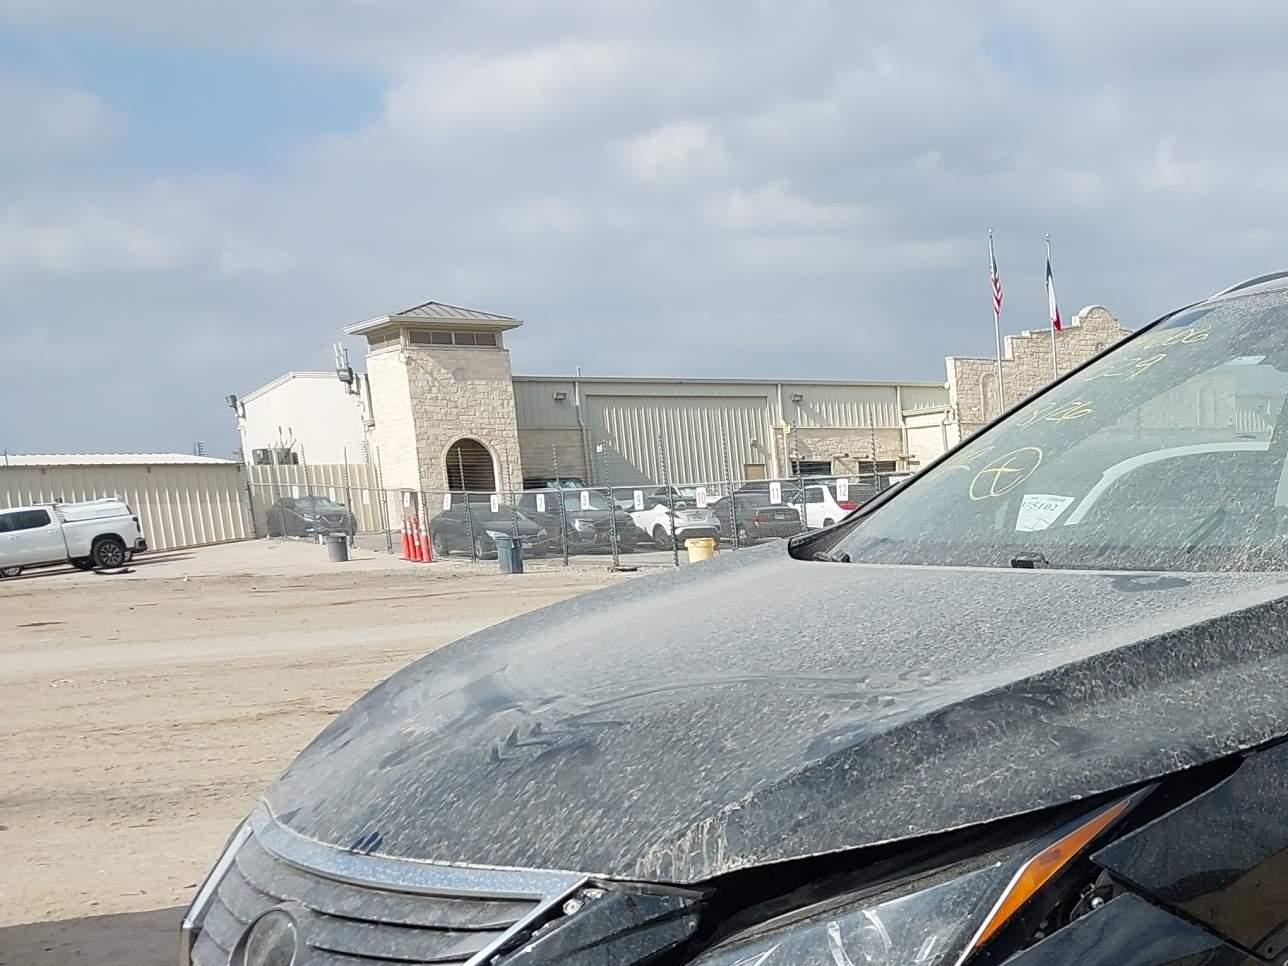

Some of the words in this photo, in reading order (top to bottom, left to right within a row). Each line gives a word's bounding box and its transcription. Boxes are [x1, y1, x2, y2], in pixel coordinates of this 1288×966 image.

[696, 491, 706, 505] 10
[771, 487, 780, 502] 11
[838, 484, 848, 498] 12
